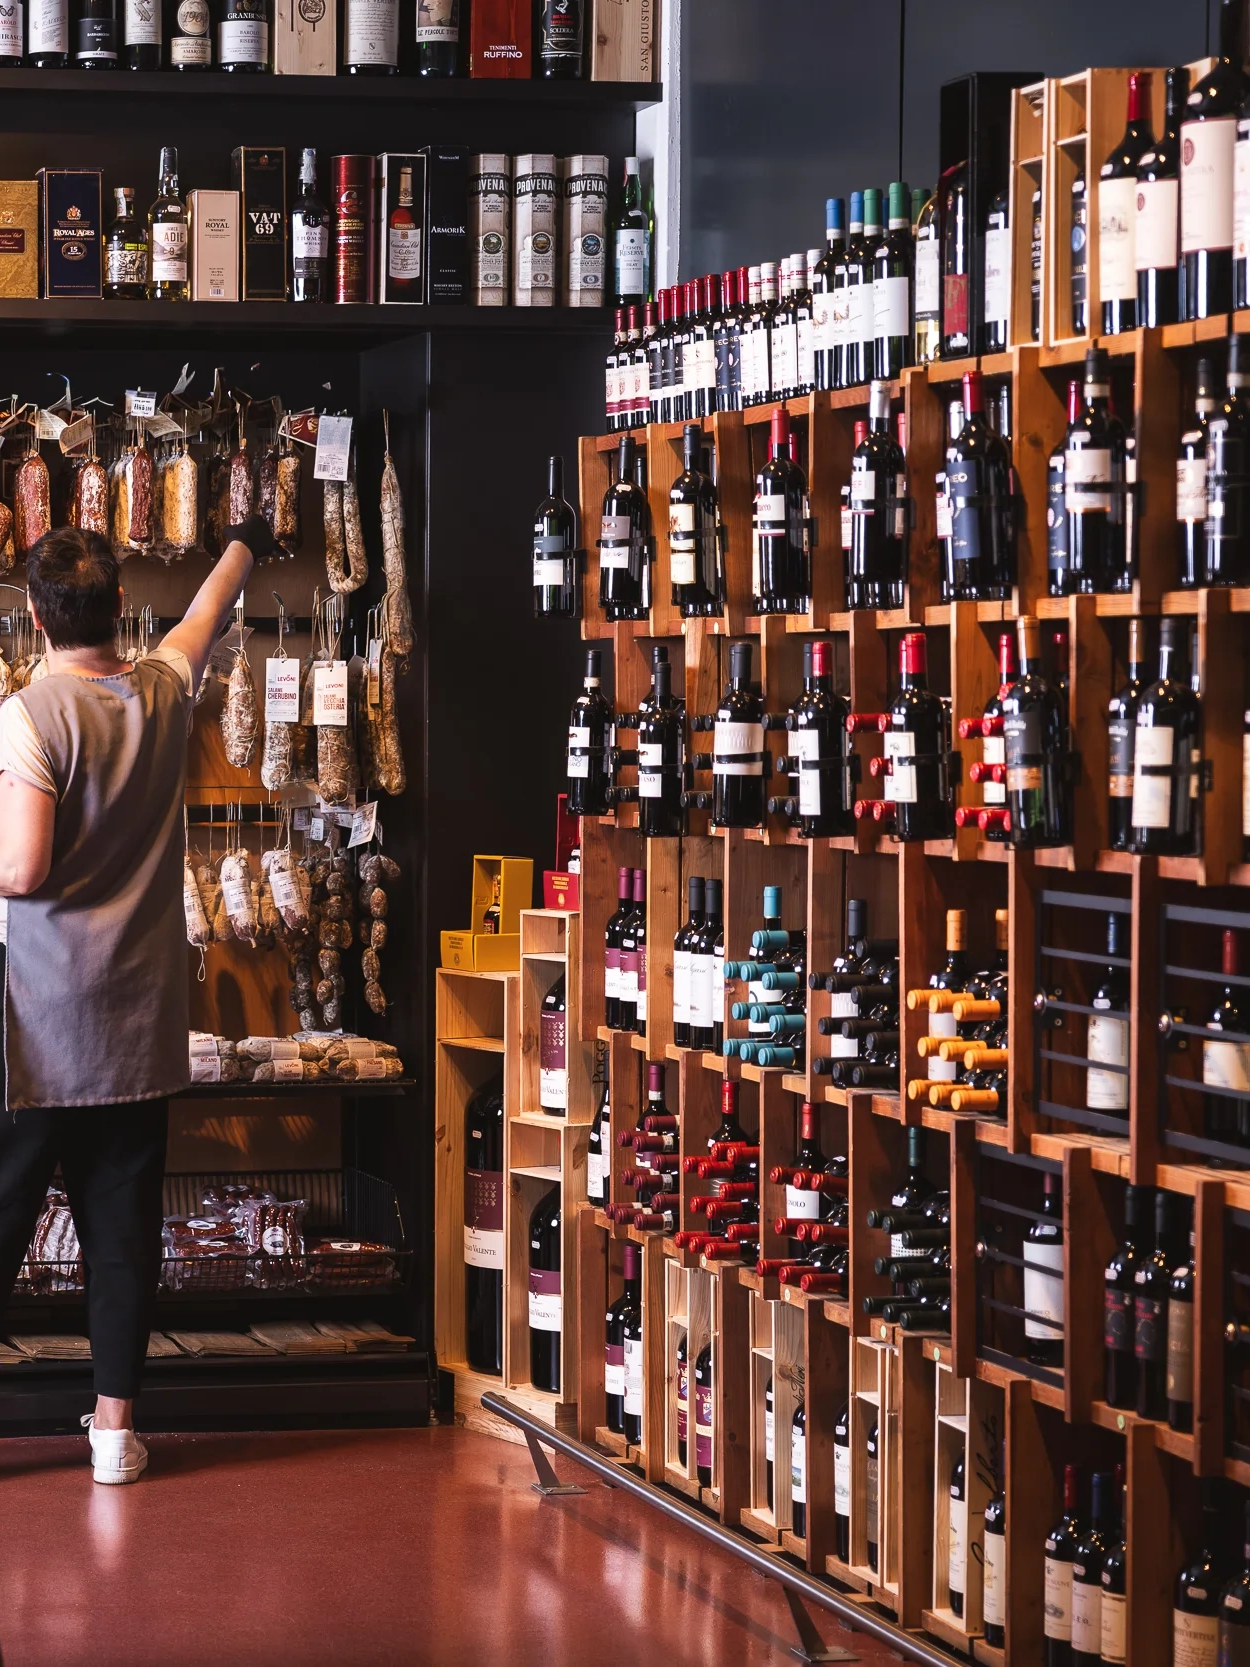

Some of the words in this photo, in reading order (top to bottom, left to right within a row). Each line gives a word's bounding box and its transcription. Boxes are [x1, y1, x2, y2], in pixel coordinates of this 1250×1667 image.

[484, 51, 523, 59] RUFFINO
[641, 48, 649, 71] SAN
[248, 213, 281, 224] VAT
[77, 229, 95, 237] AGES
[255, 223, 274, 235] 69
[431, 225, 466, 234] ARMORIK
[619, 249, 645, 257] RESERVE
